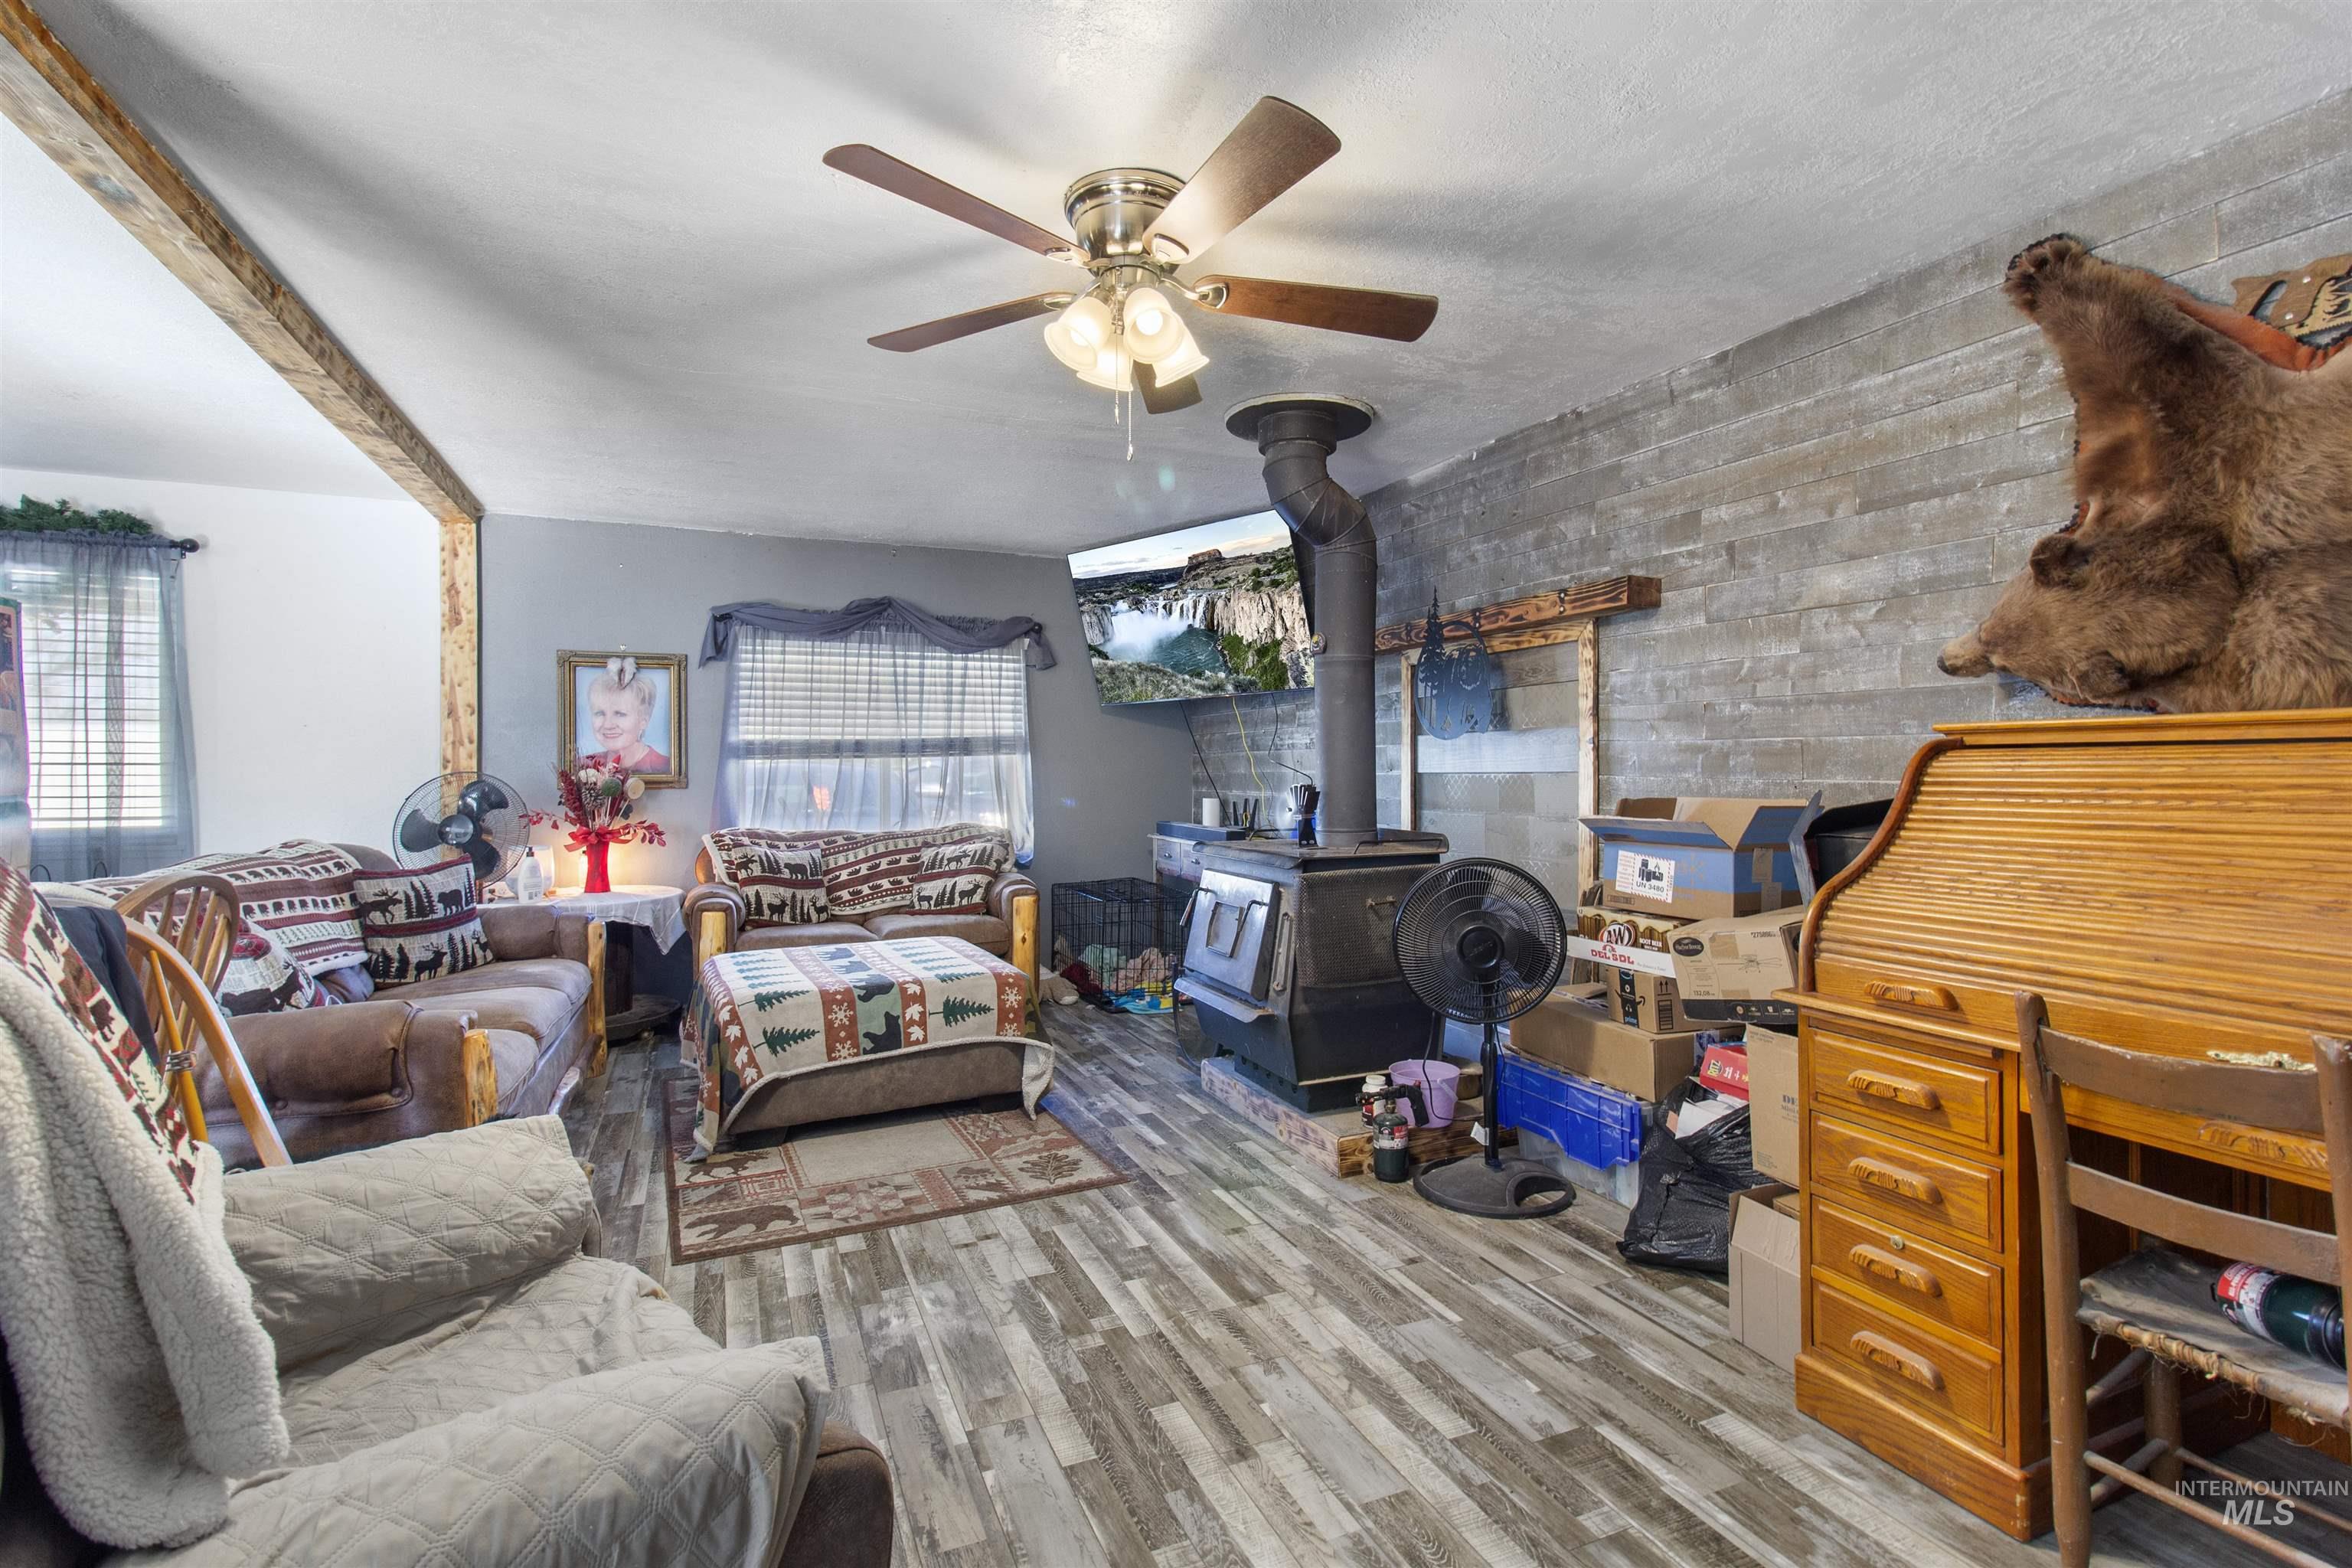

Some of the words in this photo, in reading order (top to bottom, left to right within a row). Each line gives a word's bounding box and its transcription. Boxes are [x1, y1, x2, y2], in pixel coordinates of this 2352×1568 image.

[1636, 880, 1647, 890] UN
[1648, 884, 1664, 893] 3480
[1590, 949, 1611, 960] DEL
[1625, 1016, 1638, 1024] prime
[1707, 1060, 1721, 1077] RITZ
